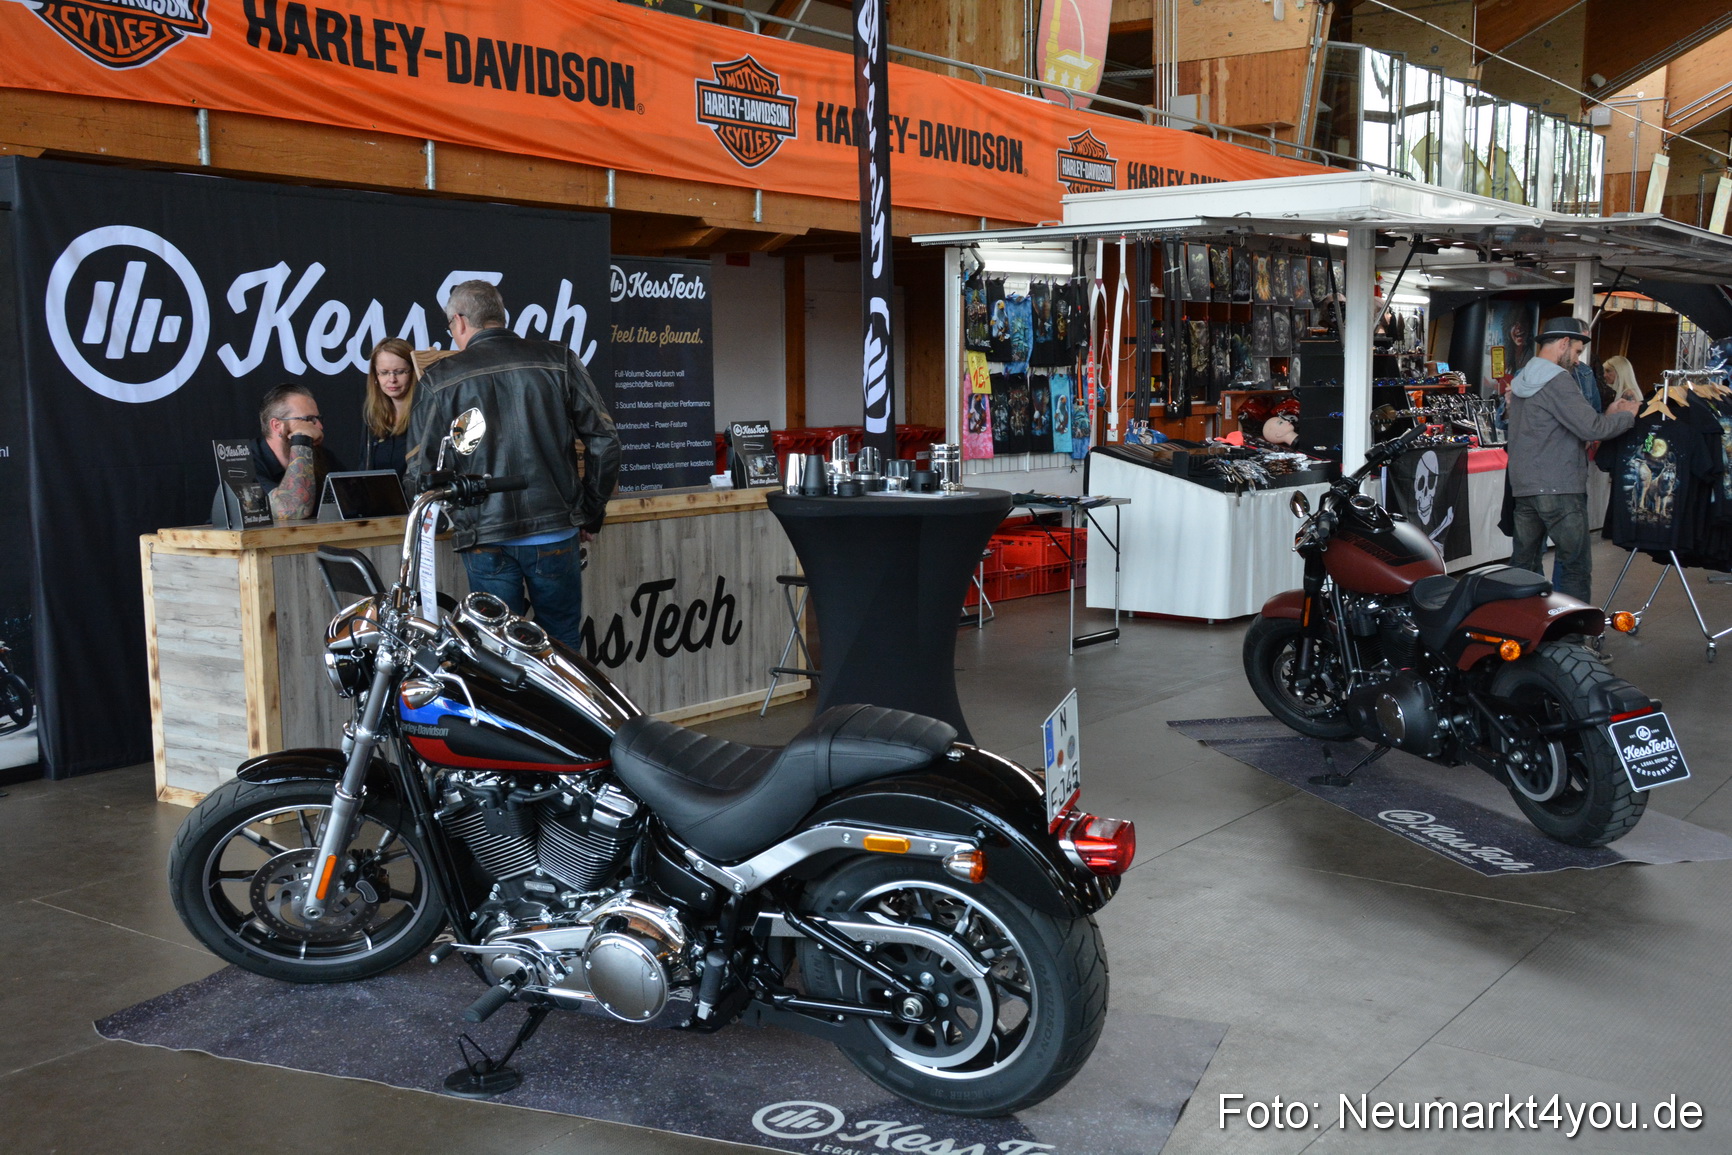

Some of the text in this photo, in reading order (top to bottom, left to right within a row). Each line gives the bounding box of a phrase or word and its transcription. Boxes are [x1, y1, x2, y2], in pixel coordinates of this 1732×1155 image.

[60, 5, 157, 55] CYCLES
[726, 66, 771, 95] MOTOR
[704, 91, 790, 127] HARLEY-DAVIDSON
[725, 126, 771, 157] CYCLES
[1062, 157, 1112, 182] HARLEY-DAVIDSON
[627, 272, 706, 299] KessTech
[611, 324, 703, 348] Feel the Sound.
[645, 369, 661, 378] Sound
[662, 370, 675, 378] durch
[620, 401, 636, 410] Sound
[637, 401, 654, 409] Modes
[680, 400, 710, 408] Performance
[616, 421, 688, 430] Marktneuheit Power-Feature
[621, 440, 712, 451] arktneuheit Active Engine Protection
[629, 463, 651, 471] Software
[652, 461, 675, 470] Upgrades
[690, 460, 714, 468] kostenlos
[619, 484, 634, 492] Made
[641, 482, 663, 491] Germany
[401, 723, 449, 737] arley-Davidson
[1059, 707, 1067, 737] N
[1623, 737, 1676, 760] KessTech
[1632, 755, 1678, 777] PERFORMANCE
[1408, 824, 1534, 871] KessTech
